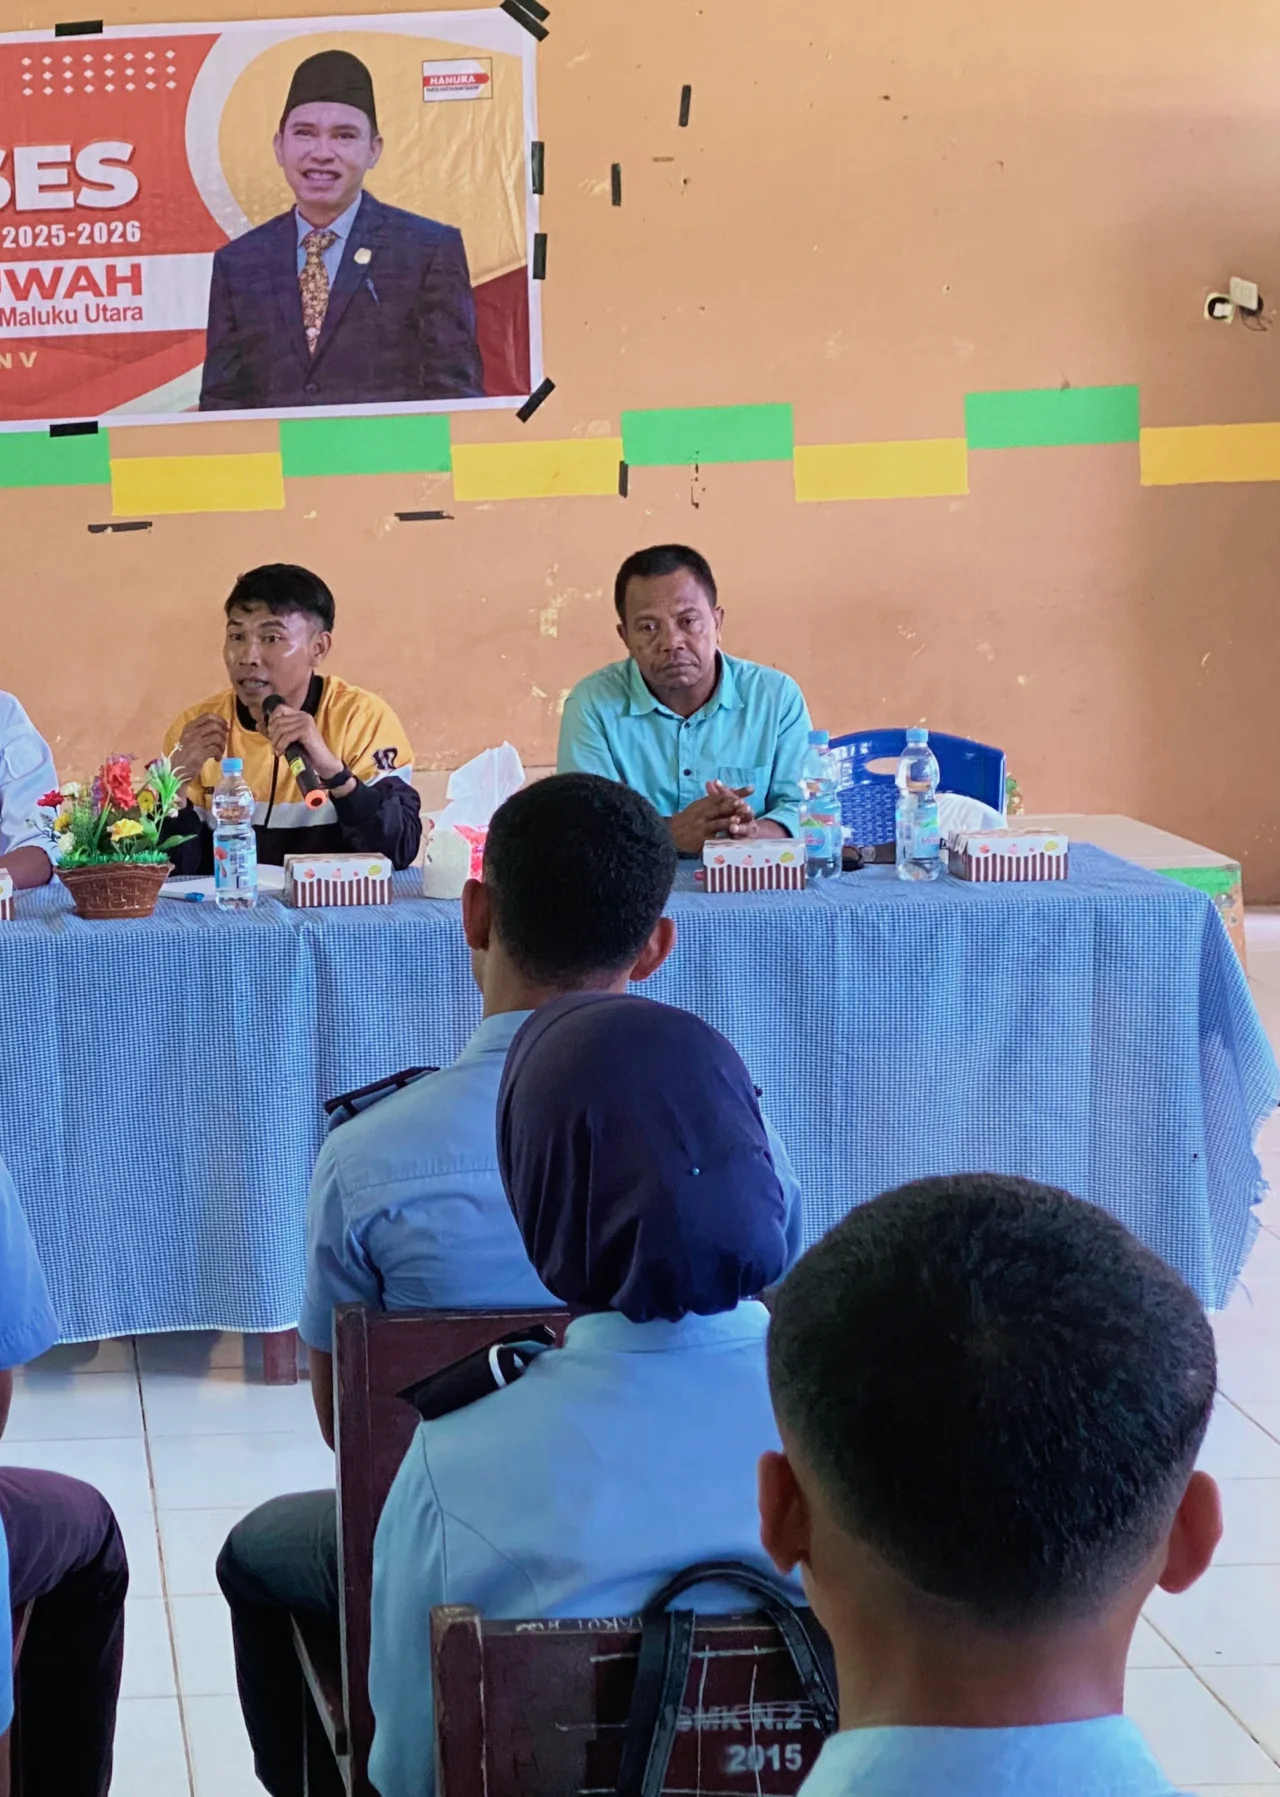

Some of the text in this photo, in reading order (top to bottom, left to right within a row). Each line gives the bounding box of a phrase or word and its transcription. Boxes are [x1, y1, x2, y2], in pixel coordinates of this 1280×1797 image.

[430, 75, 476, 86] HANURA
[1, 220, 142, 249] 2025-2026
[85, 303, 144, 324] Utara
[18, 351, 38, 369] V
[725, 1742, 803, 1773] 2015
